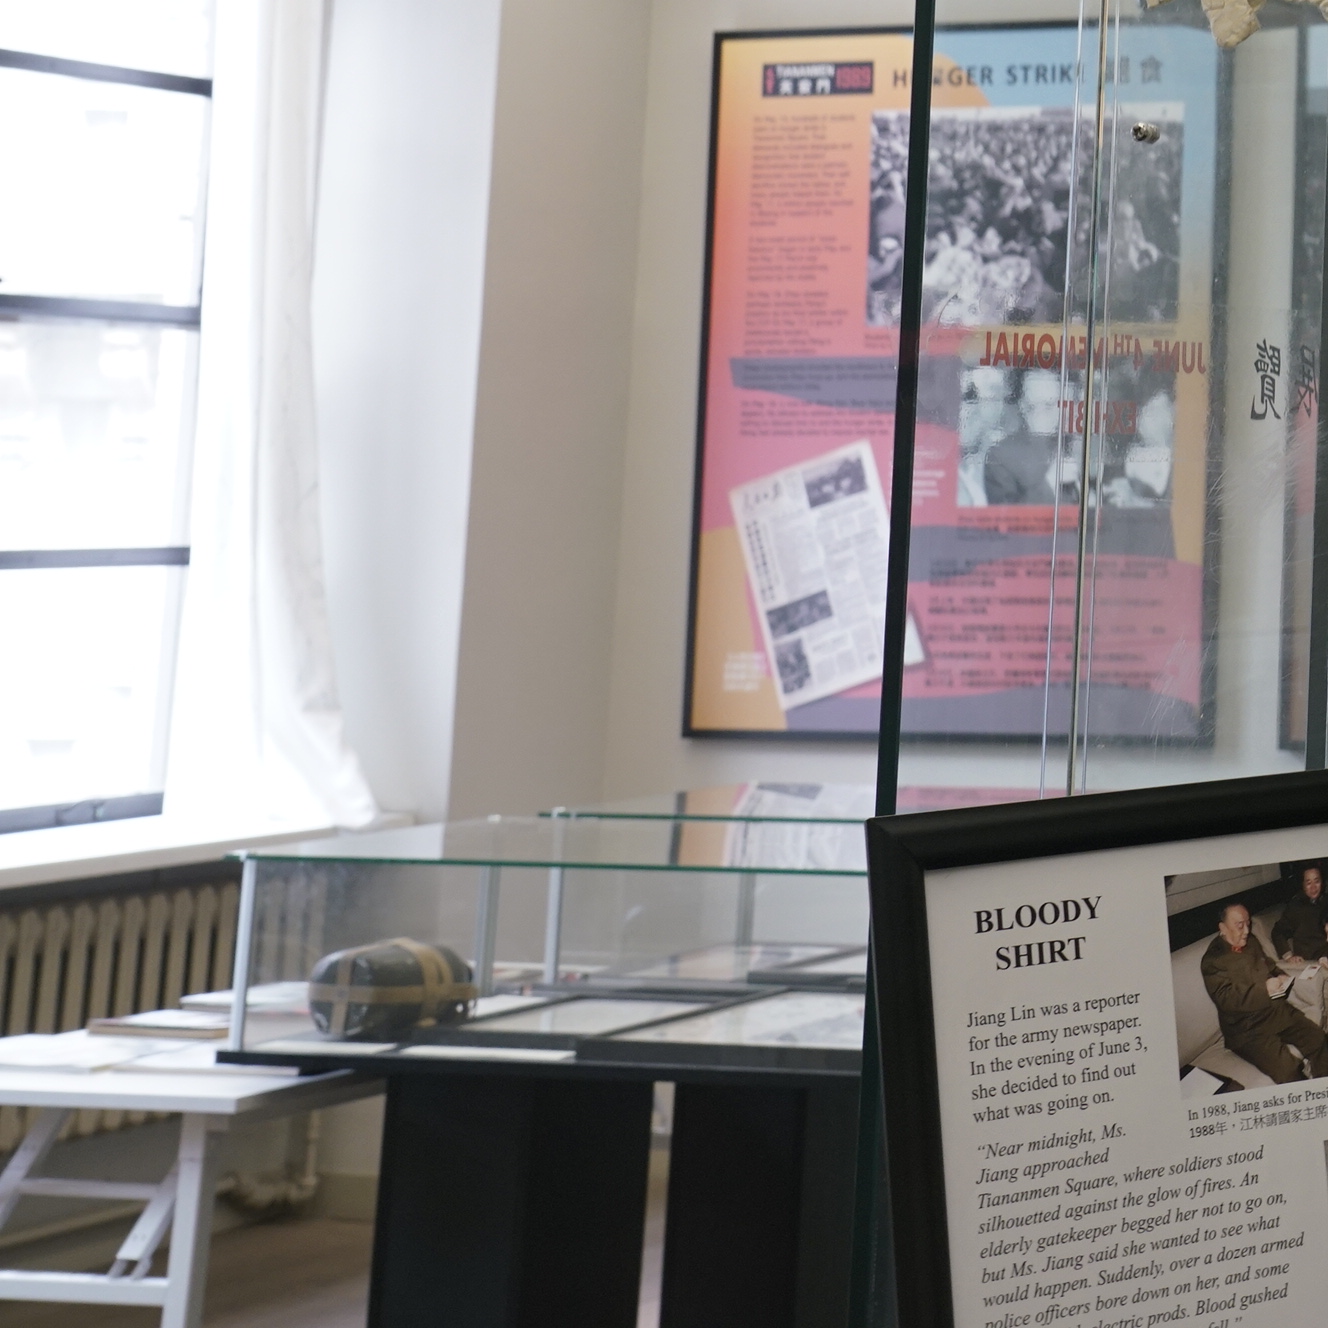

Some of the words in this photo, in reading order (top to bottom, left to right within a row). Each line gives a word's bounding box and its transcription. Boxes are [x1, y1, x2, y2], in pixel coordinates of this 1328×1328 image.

[974, 896, 1102, 934] BLOODY
[996, 936, 1086, 970] SHIRT
[967, 1011, 1006, 1028] Jiang
[1011, 1005, 1036, 1021] Lin
[1040, 1003, 1068, 1016] was
[1073, 1002, 1081, 1012] a
[1085, 993, 1140, 1013] reporter
[969, 1036, 990, 1052] for
[994, 1032, 1017, 1047] the
[1022, 1029, 1058, 1044] army
[1063, 1017, 1141, 1038] newspaper.
[970, 1061, 985, 1076] In
[990, 1057, 1013, 1072] the
[1017, 1049, 1075, 1068] evening
[1079, 1042, 1095, 1059] of
[1098, 1042, 1130, 1056] June
[1135, 1036, 1148, 1052] 3,
[972, 1084, 997, 1100] she
[1001, 1073, 1058, 1095] decided
[1062, 1074, 1076, 1085] to
[1081, 1065, 1109, 1083] find
[1114, 1063, 1136, 1078] out
[973, 1106, 1010, 1123] what
[1014, 1103, 1043, 1116] was
[1048, 1094, 1088, 1112] going
[1092, 1092, 1114, 1104] on.
[1188, 1109, 1199, 1121] In
[1203, 1104, 1230, 1118] 1988,
[1233, 1102, 1260, 1113] Jiang
[1263, 1096, 1285, 1108] asks
[1288, 1093, 1302, 1104] for
[977, 1142, 1024, 1159] “Near
[1028, 1128, 1096, 1152] midnight,
[1101, 1123, 1126, 1140] Ms.
[975, 1168, 1019, 1185] Jiang
[1023, 1147, 1110, 1180] approached
[978, 1185, 1059, 1209] Tiananmen
[1064, 1176, 1118, 1196] Square,
[1123, 1166, 1165, 1182] where
[1169, 1156, 1222, 1175] soldiers
[1226, 1144, 1264, 1165] stood
[978, 1204, 1061, 1234] silhouetted
[1065, 1198, 1118, 1221] against
[1122, 1192, 1143, 1208] the
[1147, 1186, 1181, 1207] glow
[1185, 1179, 1201, 1200] of
[1200, 1178, 1235, 1198] fires.
[1239, 1172, 1258, 1187] An
[980, 1236, 1032, 1259] elderly
[1036, 1224, 1117, 1253] gatekeeper
[1121, 1209, 1171, 1234] begged
[1175, 1207, 1198, 1222] her
[1202, 1203, 1224, 1217] not
[1228, 1201, 1241, 1213] to
[1245, 1197, 1262, 1214] go
[1266, 1193, 1287, 1206] on,
[981, 1268, 1006, 1284] but
[1010, 1261, 1037, 1278] Ms.
[1041, 1255, 1084, 1272] Jiang
[1088, 1243, 1119, 1263] said
[1122, 1240, 1146, 1257] she
[1150, 1228, 1200, 1251] wanted
[1204, 1229, 1217, 1241] to
[1221, 1225, 1243, 1238] see
[1247, 1216, 1280, 1232] what
[983, 1284, 1030, 1307] would
[1034, 1278, 1092, 1299] happen.
[1097, 1260, 1164, 1286] Suddenly,
[1169, 1256, 1200, 1272] over
[1204, 1254, 1212, 1265] a
[1217, 1245, 1256, 1262] dozen
[1261, 1231, 1305, 1254] armed
[1035, 1302, 1090, 1326] officers
[1095, 1295, 1128, 1311] bore
[1132, 1287, 1169, 1304] down
[1174, 1283, 1191, 1295] on
[1196, 1276, 1220, 1291] her,
[1225, 1266, 1251, 1285] and
[1254, 1263, 1290, 1279] some
[1147, 1304, 1190, 1328] prods.
[1195, 1293, 1236, 1316] Blood
[1239, 1282, 1289, 1311] gushed
